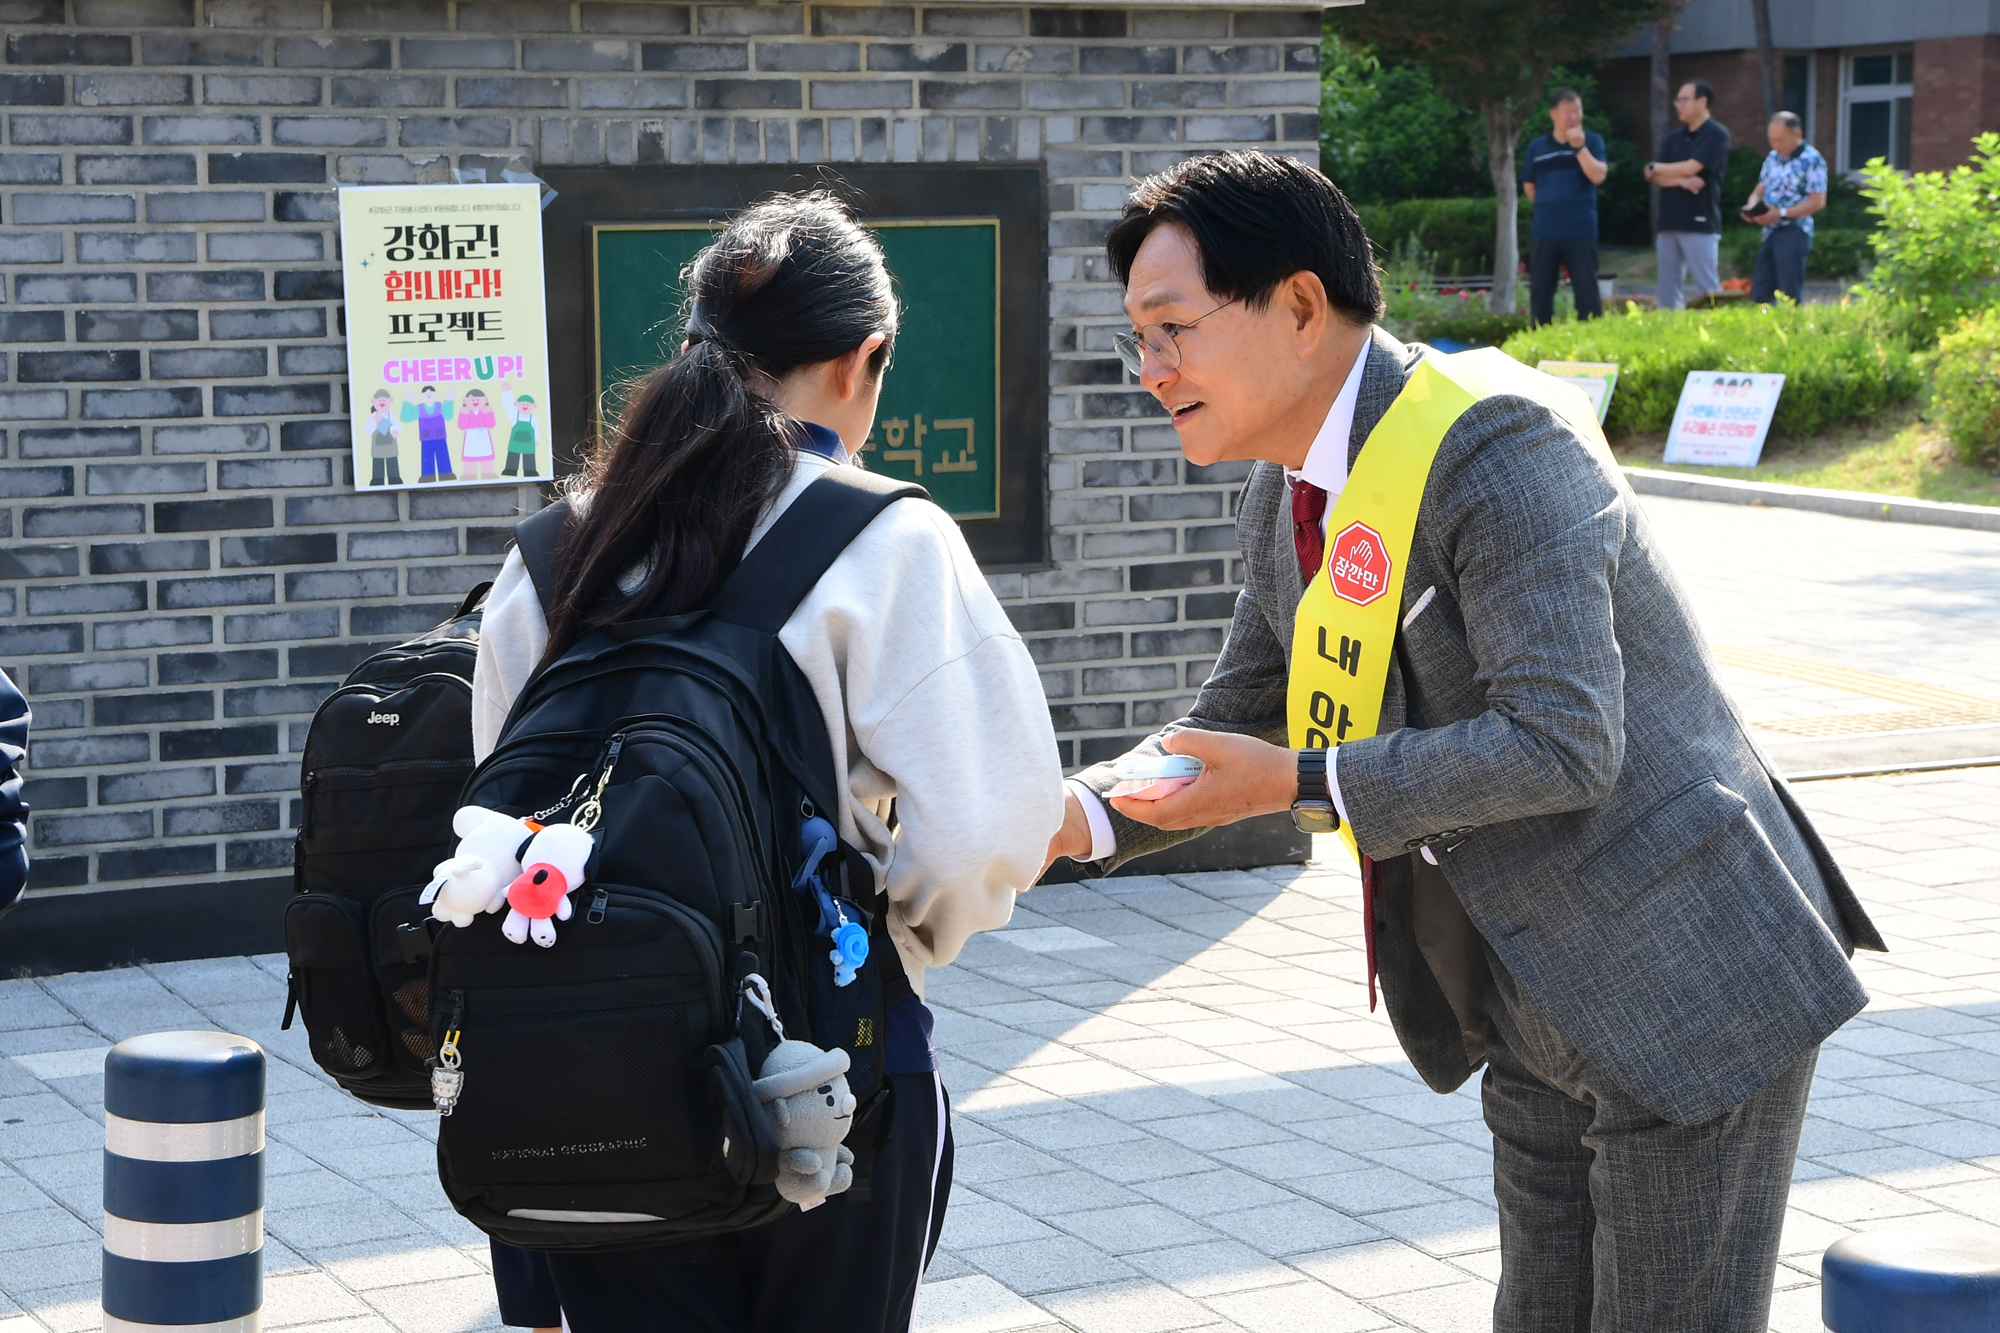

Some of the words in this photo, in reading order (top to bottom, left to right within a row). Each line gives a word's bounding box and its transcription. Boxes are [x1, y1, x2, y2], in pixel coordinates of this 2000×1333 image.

[383, 223, 499, 262] 강화군!
[384, 268, 502, 302] 힘!내!라!
[387, 310, 505, 344] 프로젝트
[863, 413, 978, 477] 학교
[1334, 555, 1379, 592] 잠깐만
[1317, 625, 1362, 677] 내
[367, 711, 400, 726] Jeep
[491, 1146, 555, 1160] NATIONAL
[561, 1137, 647, 1155] GEOGRAPHIC
